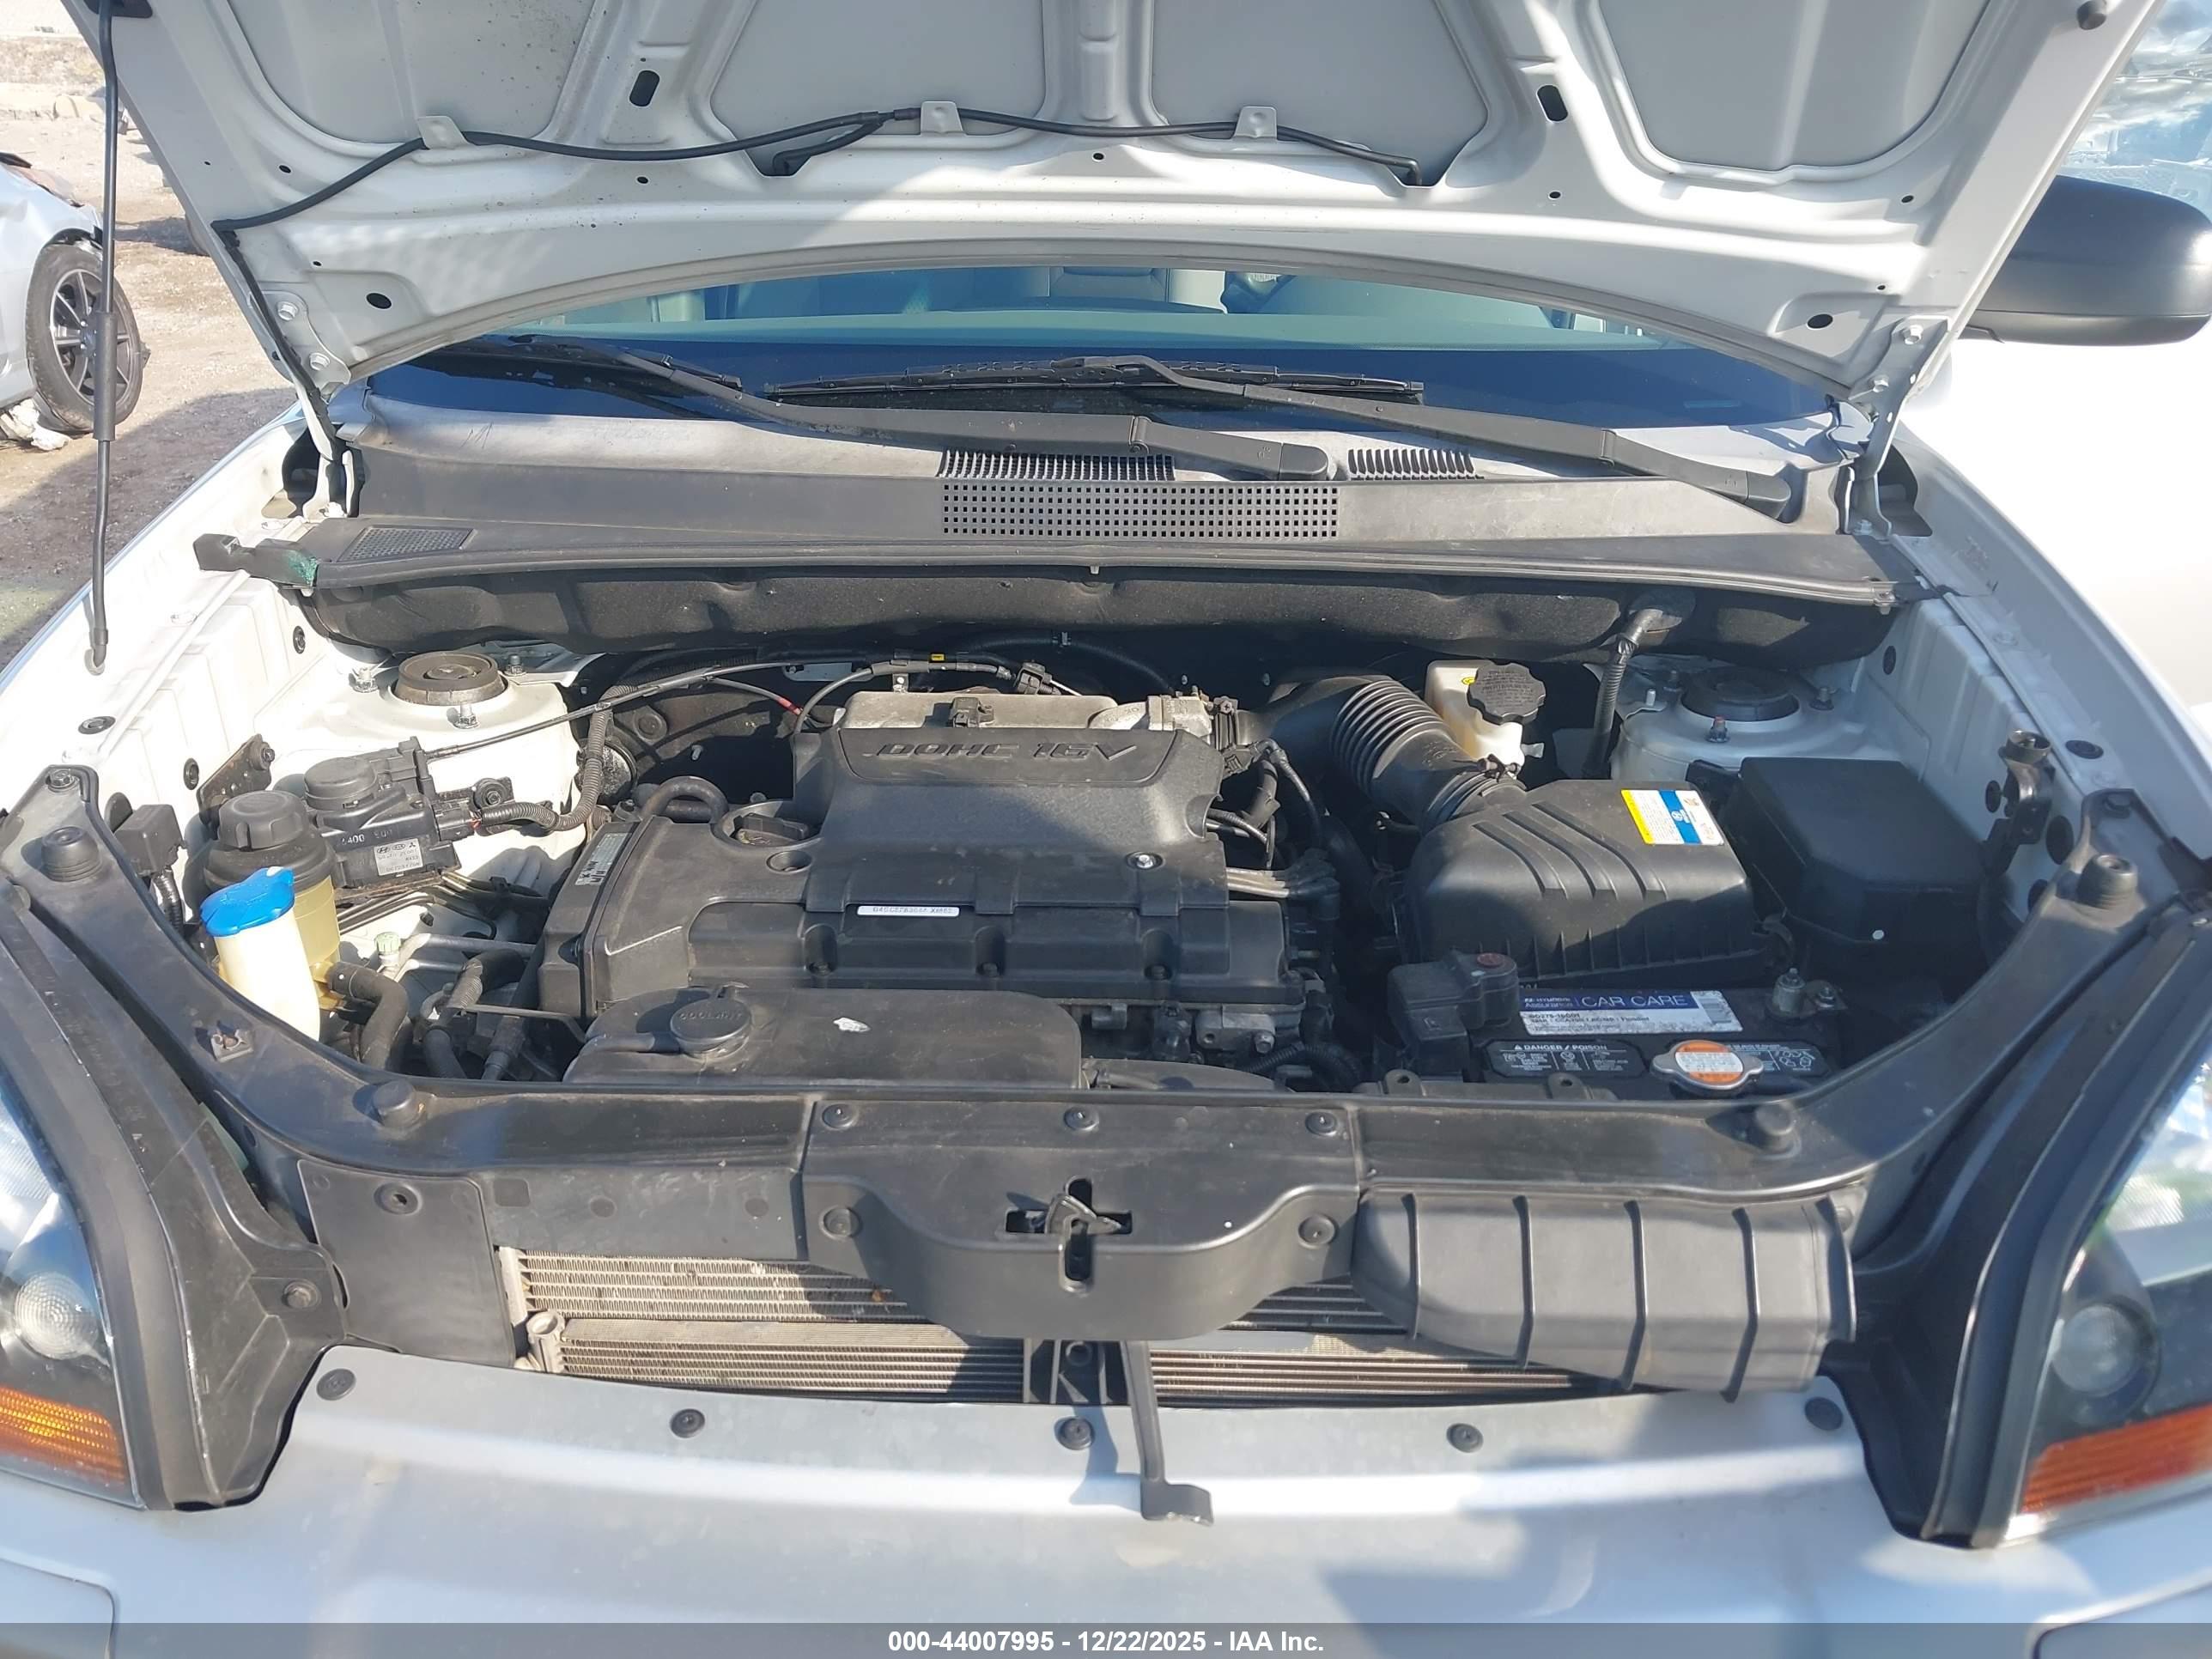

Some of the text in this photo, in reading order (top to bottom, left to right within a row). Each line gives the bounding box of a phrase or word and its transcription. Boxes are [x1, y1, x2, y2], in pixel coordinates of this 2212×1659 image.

[876, 742, 1138, 761] DOHC 16V
[1581, 994, 1688, 1007] CAR CARE
